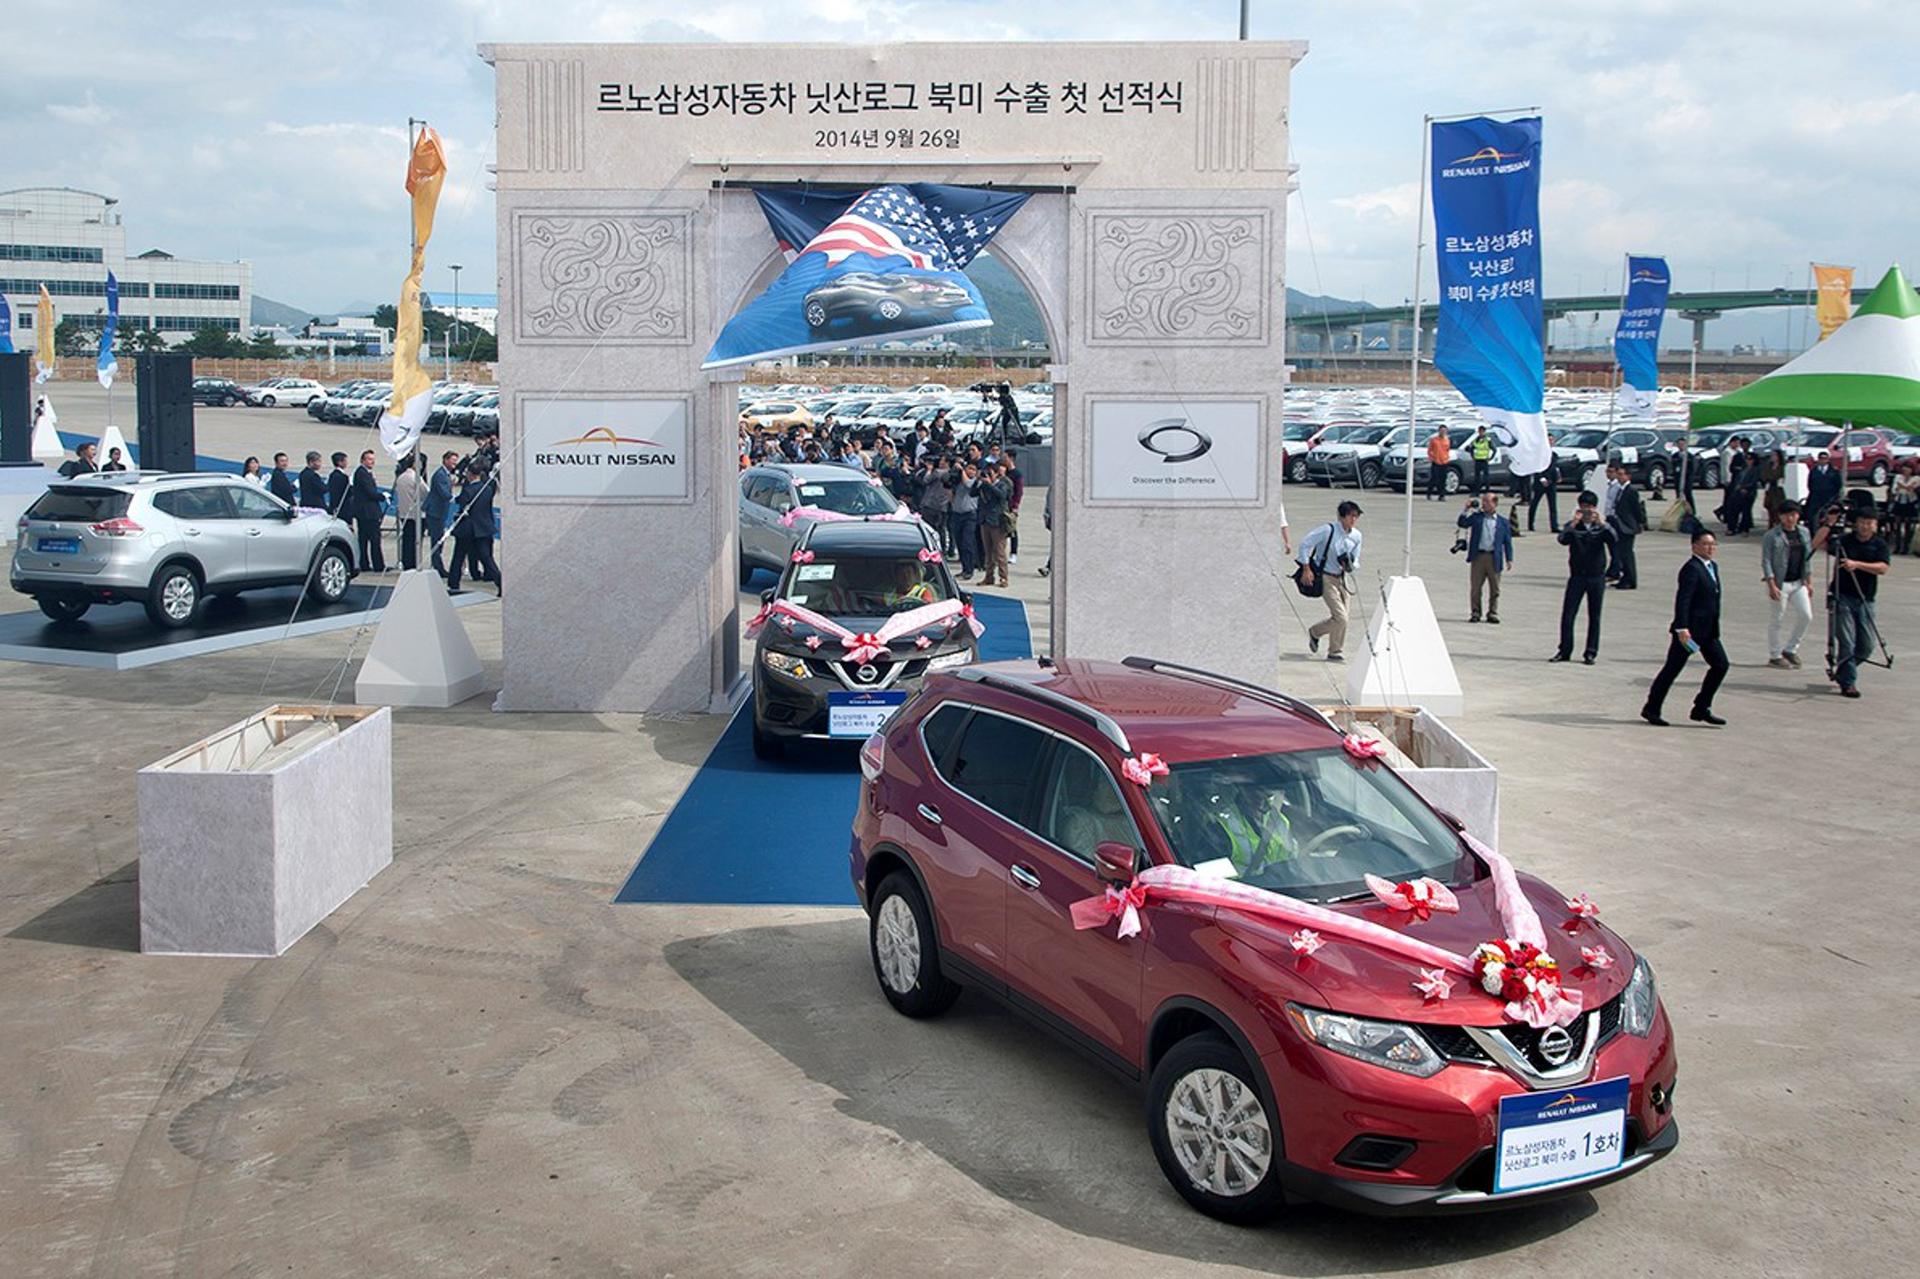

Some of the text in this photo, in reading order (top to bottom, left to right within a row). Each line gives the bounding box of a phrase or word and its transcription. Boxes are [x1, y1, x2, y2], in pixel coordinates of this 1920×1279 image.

[597, 82, 1183, 116] 르노삼성자동차 닛산로그 북미 수출 첫 선적식
[815, 129, 960, 148] 2014년 9월 26일
[1442, 166, 1490, 178] RENAULT
[535, 454, 676, 465] RENAULT NISSAN
[1583, 1131, 1620, 1157] 1호차
